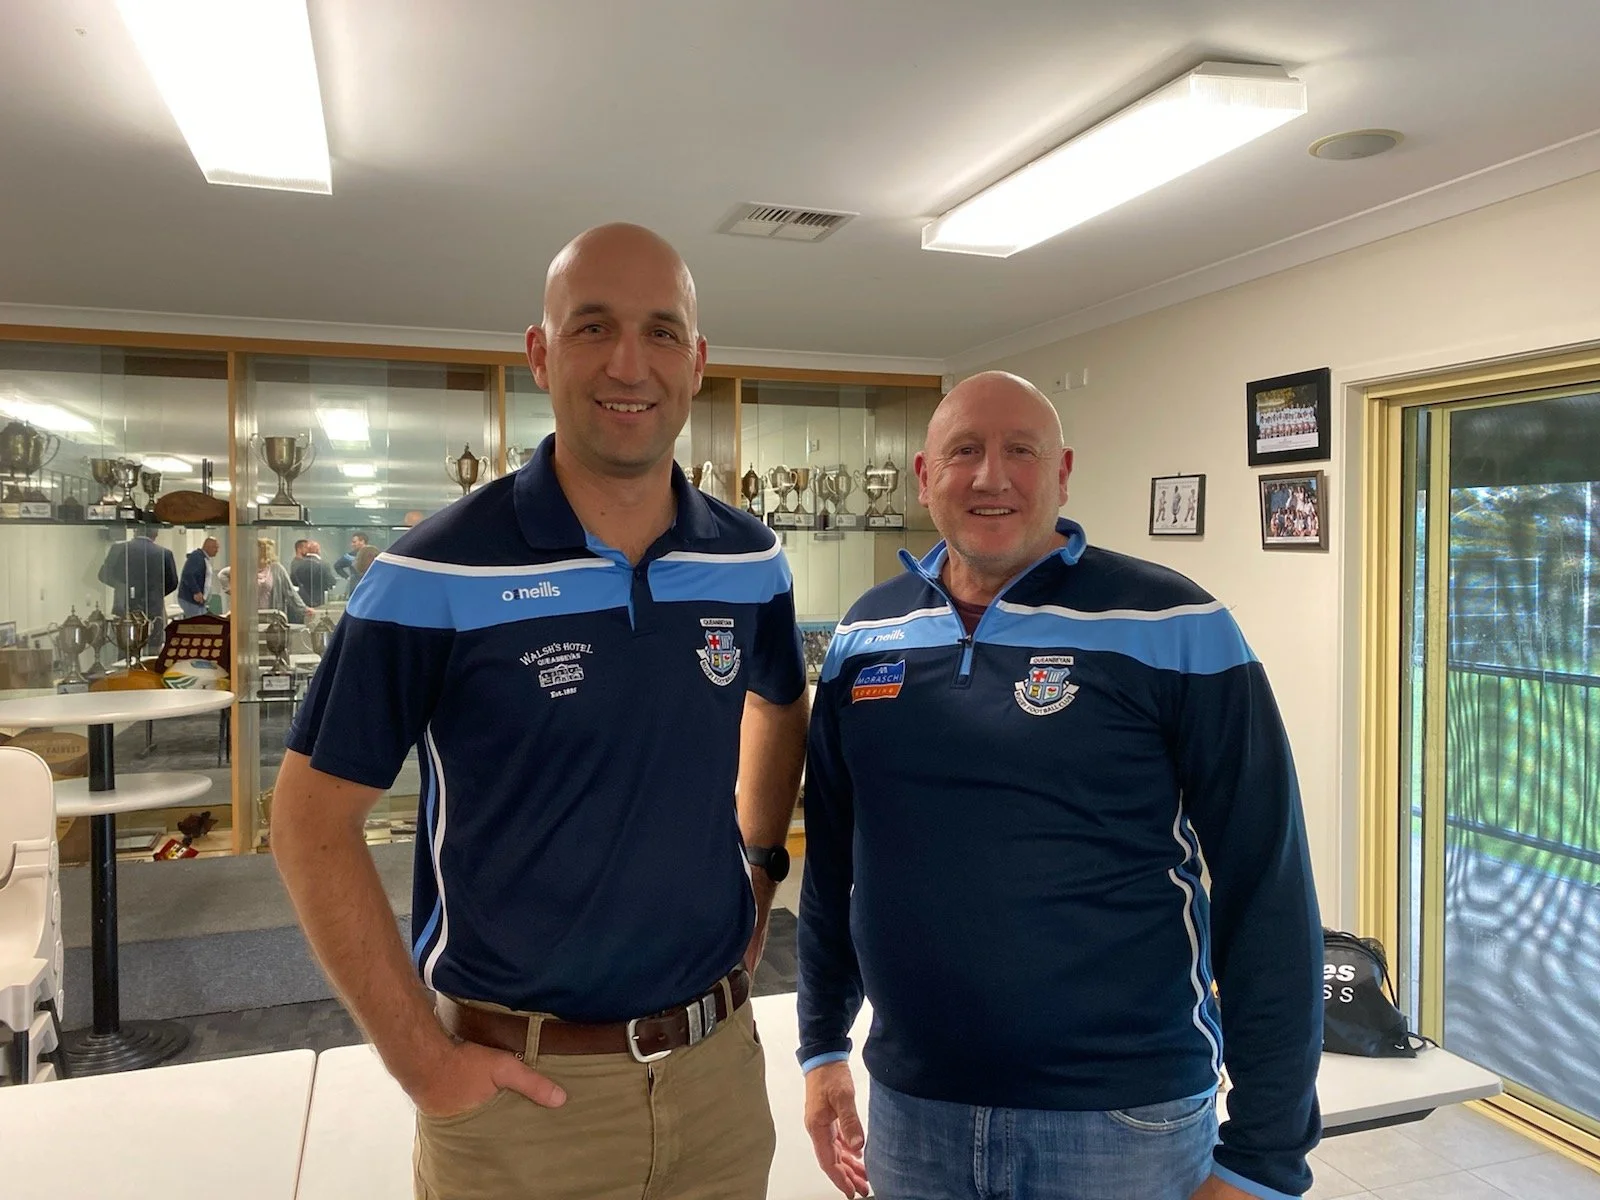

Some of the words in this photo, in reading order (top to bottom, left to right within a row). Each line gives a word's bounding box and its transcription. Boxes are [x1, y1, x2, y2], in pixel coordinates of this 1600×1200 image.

[520, 643, 561, 666] WALSH'S
[562, 642, 593, 654] HOTEL
[857, 673, 902, 684] MORASCHI
